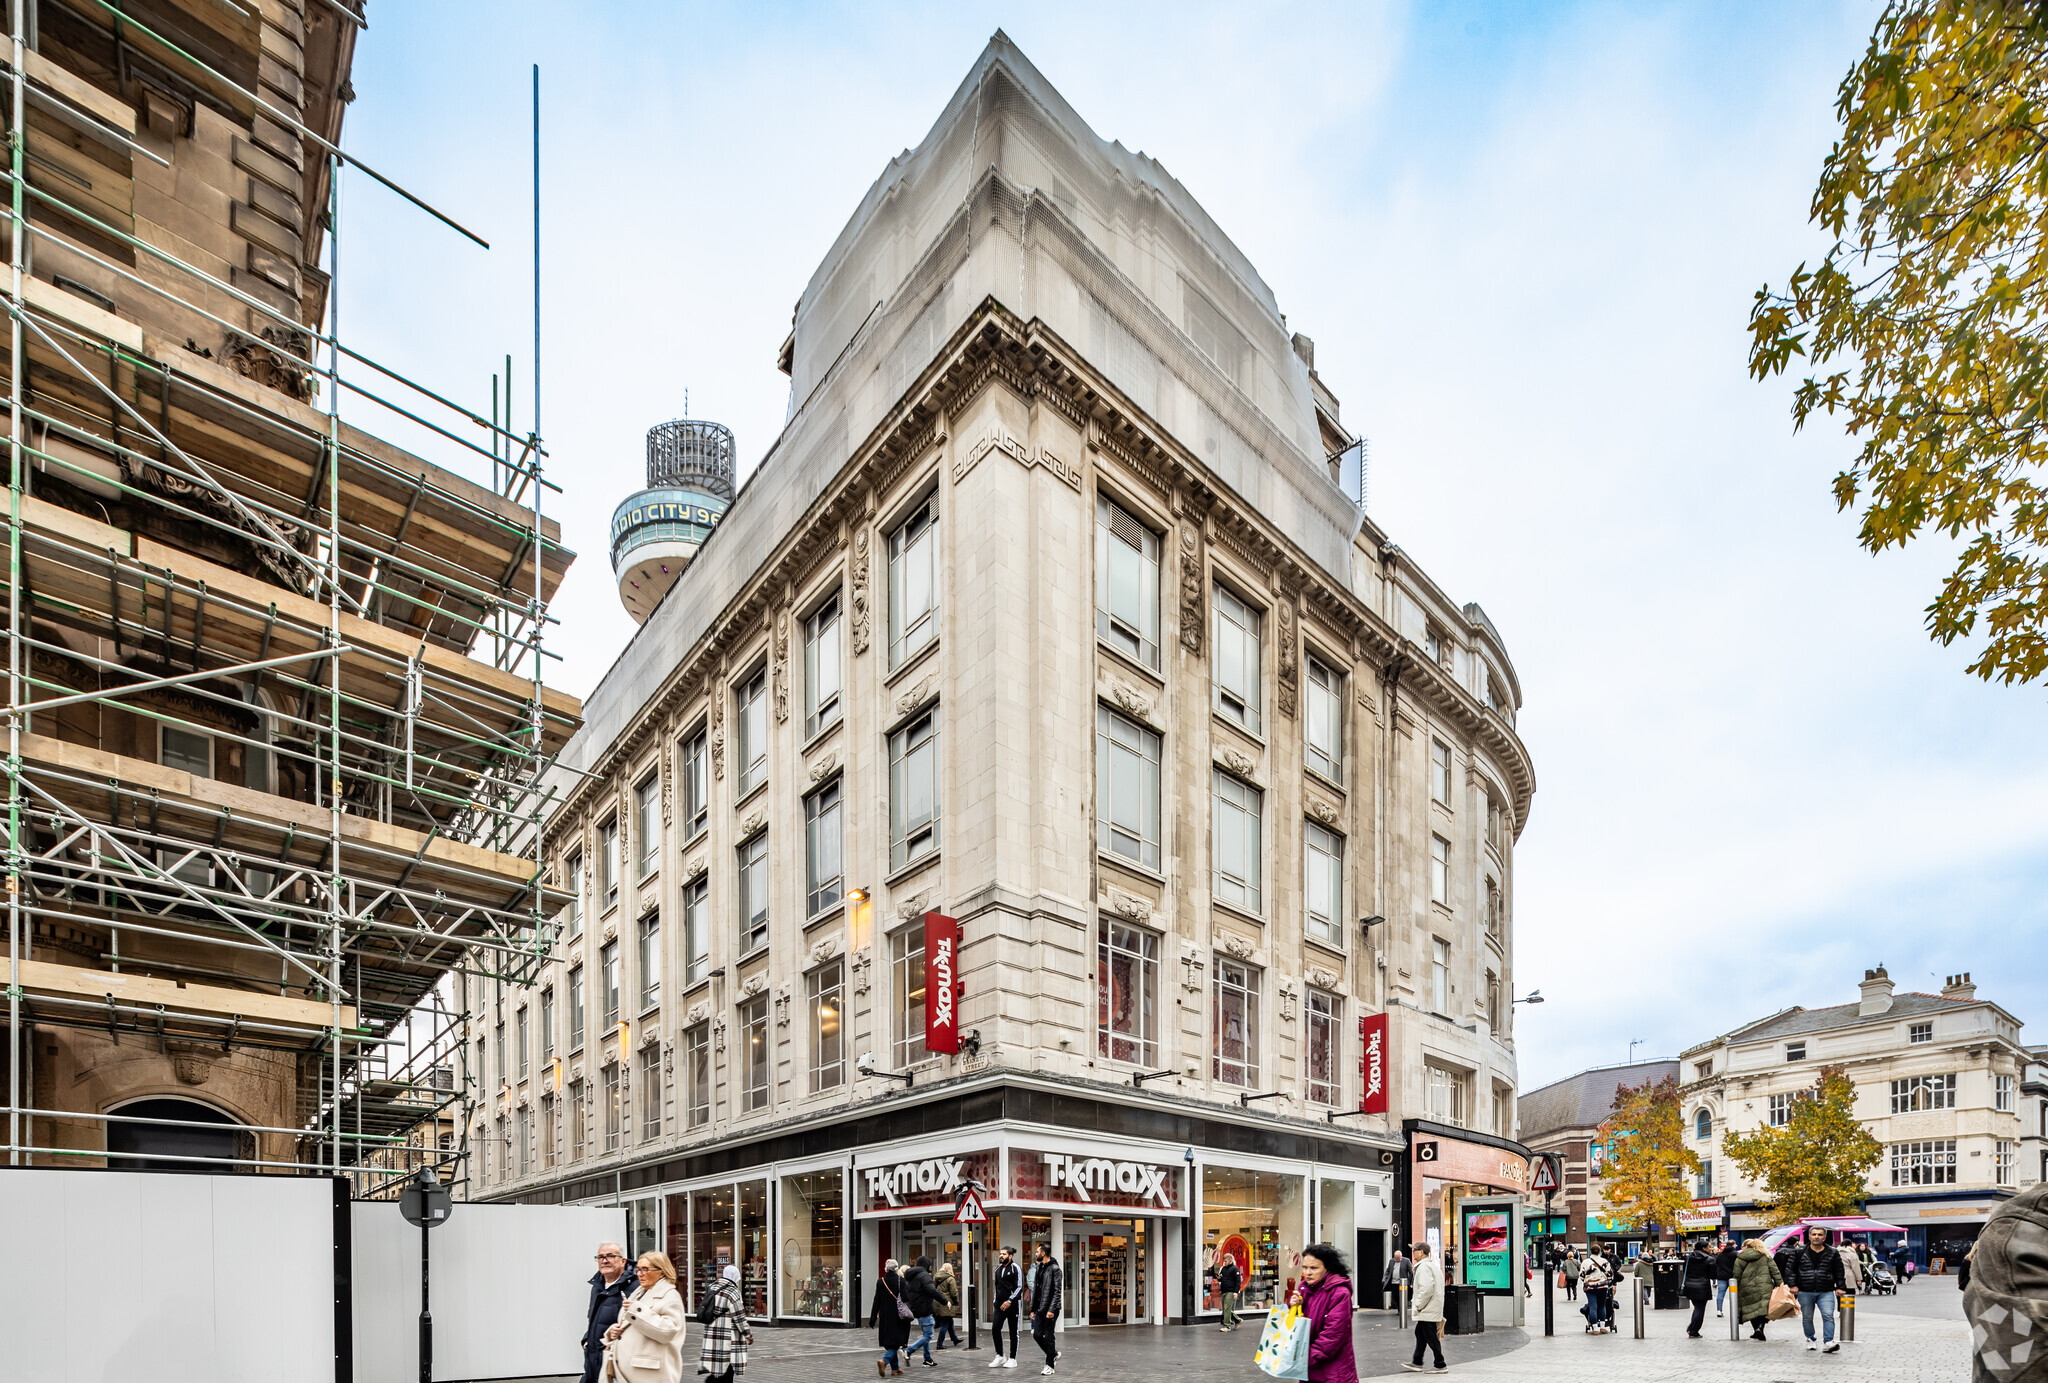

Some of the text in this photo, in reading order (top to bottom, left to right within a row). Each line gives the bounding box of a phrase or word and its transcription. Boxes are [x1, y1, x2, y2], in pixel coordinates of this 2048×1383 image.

[613, 508, 642, 540] ADIO
[647, 504, 691, 519] CITY
[964, 1062, 984, 1070] STREET
[1892, 1154, 1956, 1167] TATTOO
